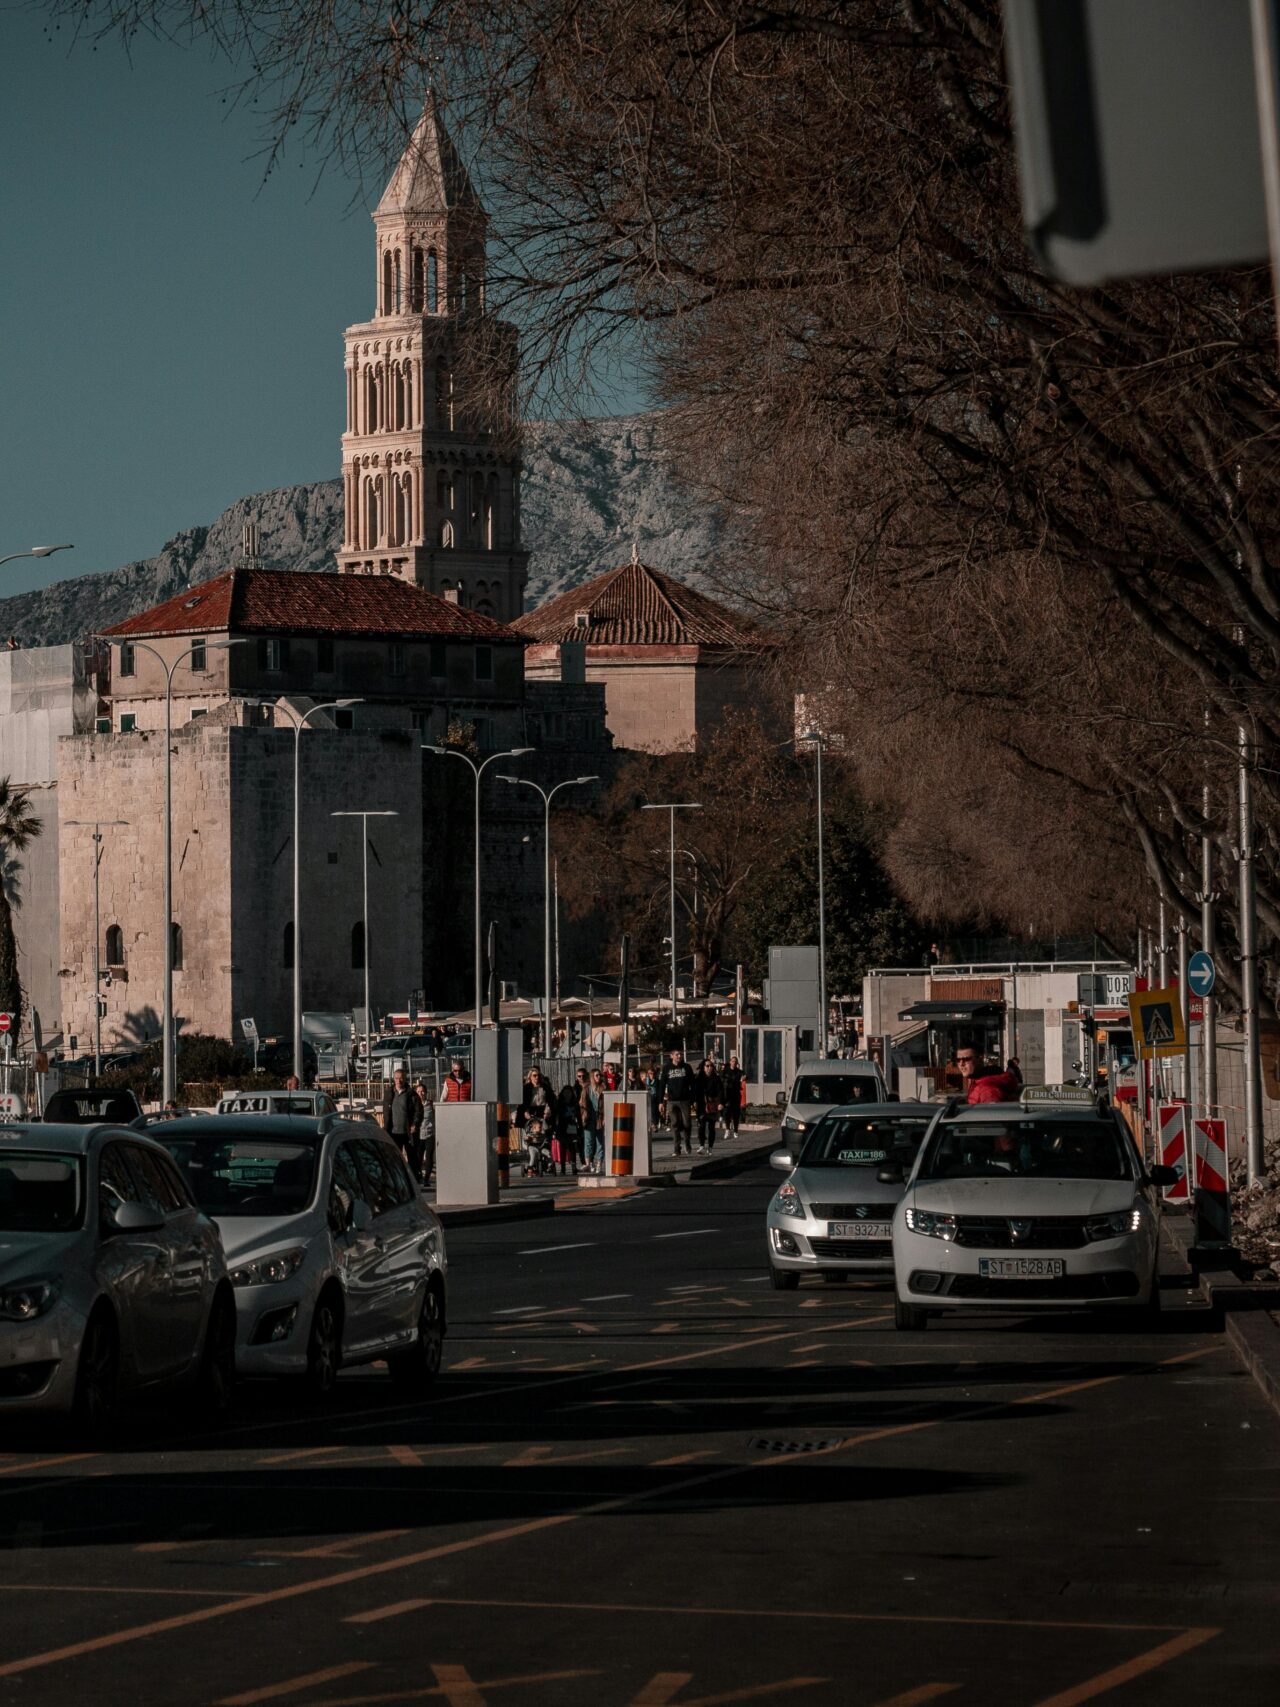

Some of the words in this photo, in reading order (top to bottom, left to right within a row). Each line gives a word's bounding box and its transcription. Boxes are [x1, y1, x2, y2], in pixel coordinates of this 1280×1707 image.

[222, 1099, 264, 1113] TAXI
[842, 1151, 864, 1159] TAXI
[835, 1224, 847, 1236] ST
[990, 1261, 1004, 1275] ST
